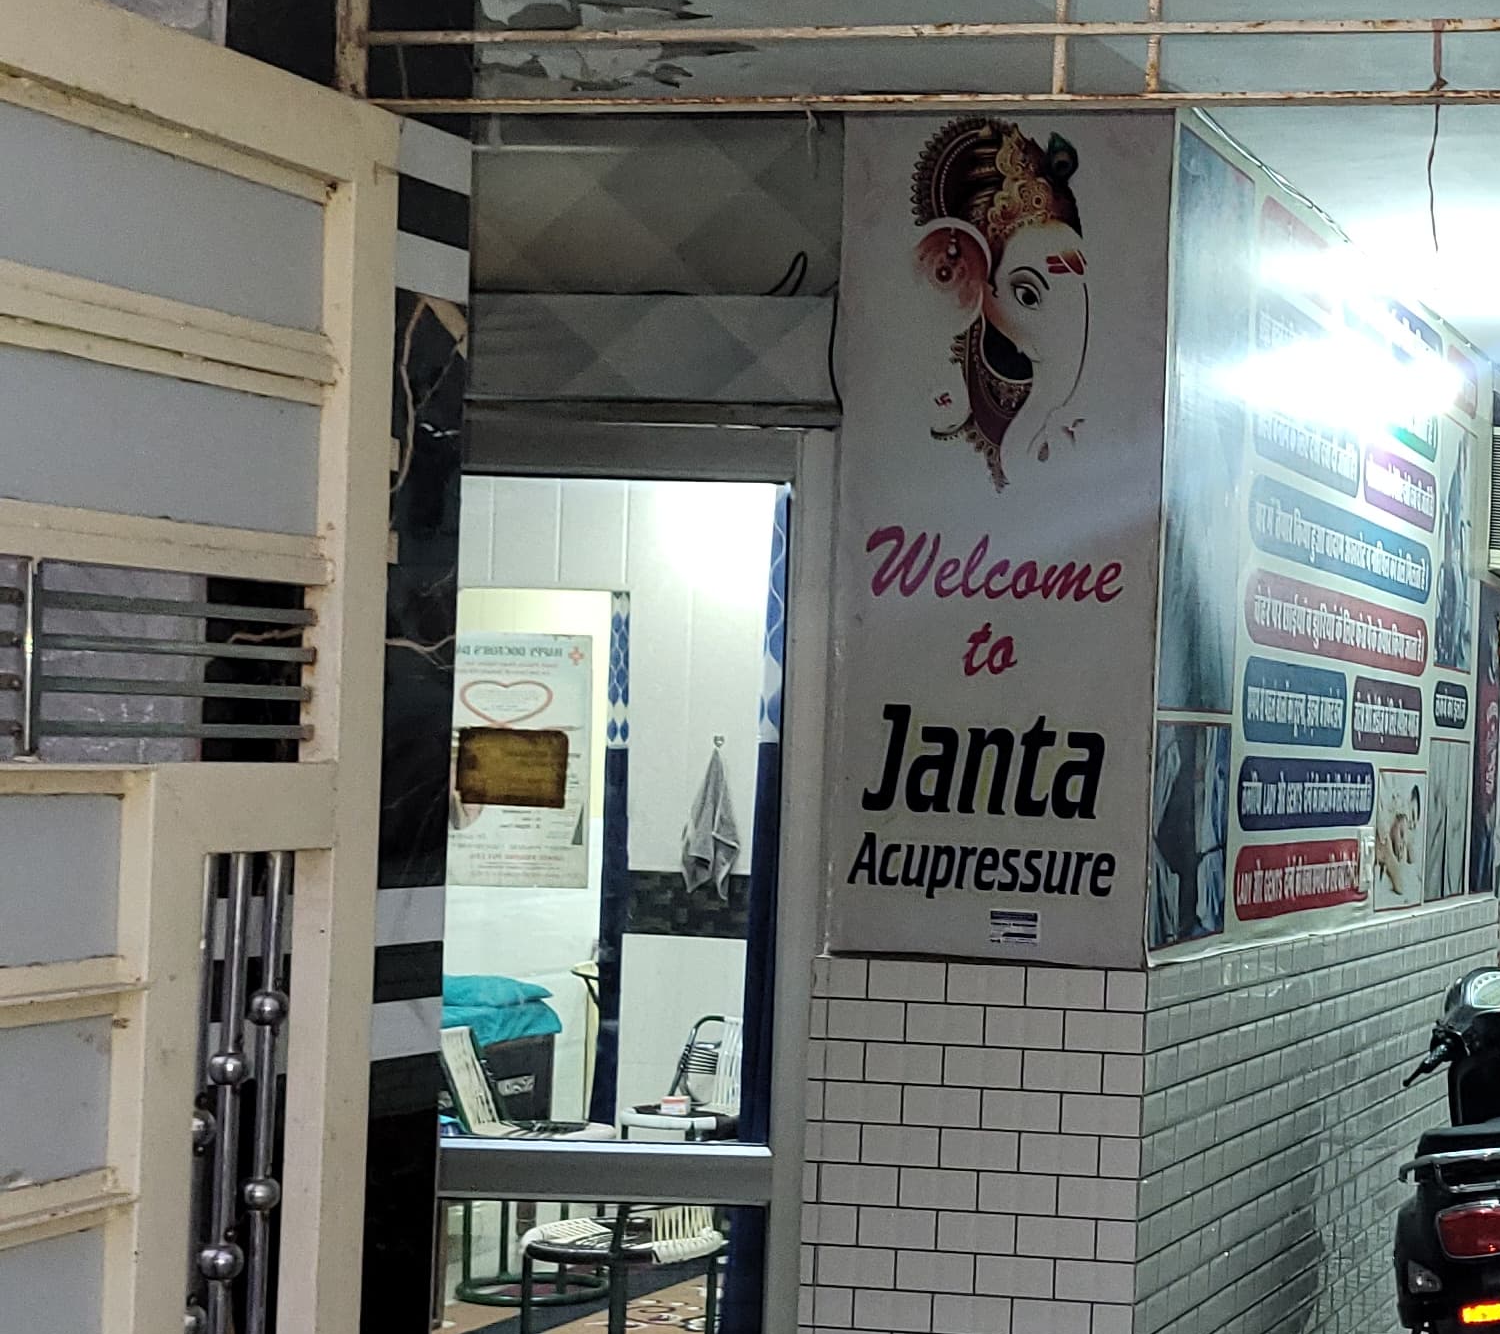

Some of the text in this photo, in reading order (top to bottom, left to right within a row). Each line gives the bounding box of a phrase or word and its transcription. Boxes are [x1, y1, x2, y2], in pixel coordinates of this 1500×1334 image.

[866, 525, 1123, 603] Welcome
[963, 623, 1018, 676] to
[861, 704, 1105, 819] Janta
[847, 831, 1116, 899] Acupressure
[1237, 871, 1252, 906] LADY
